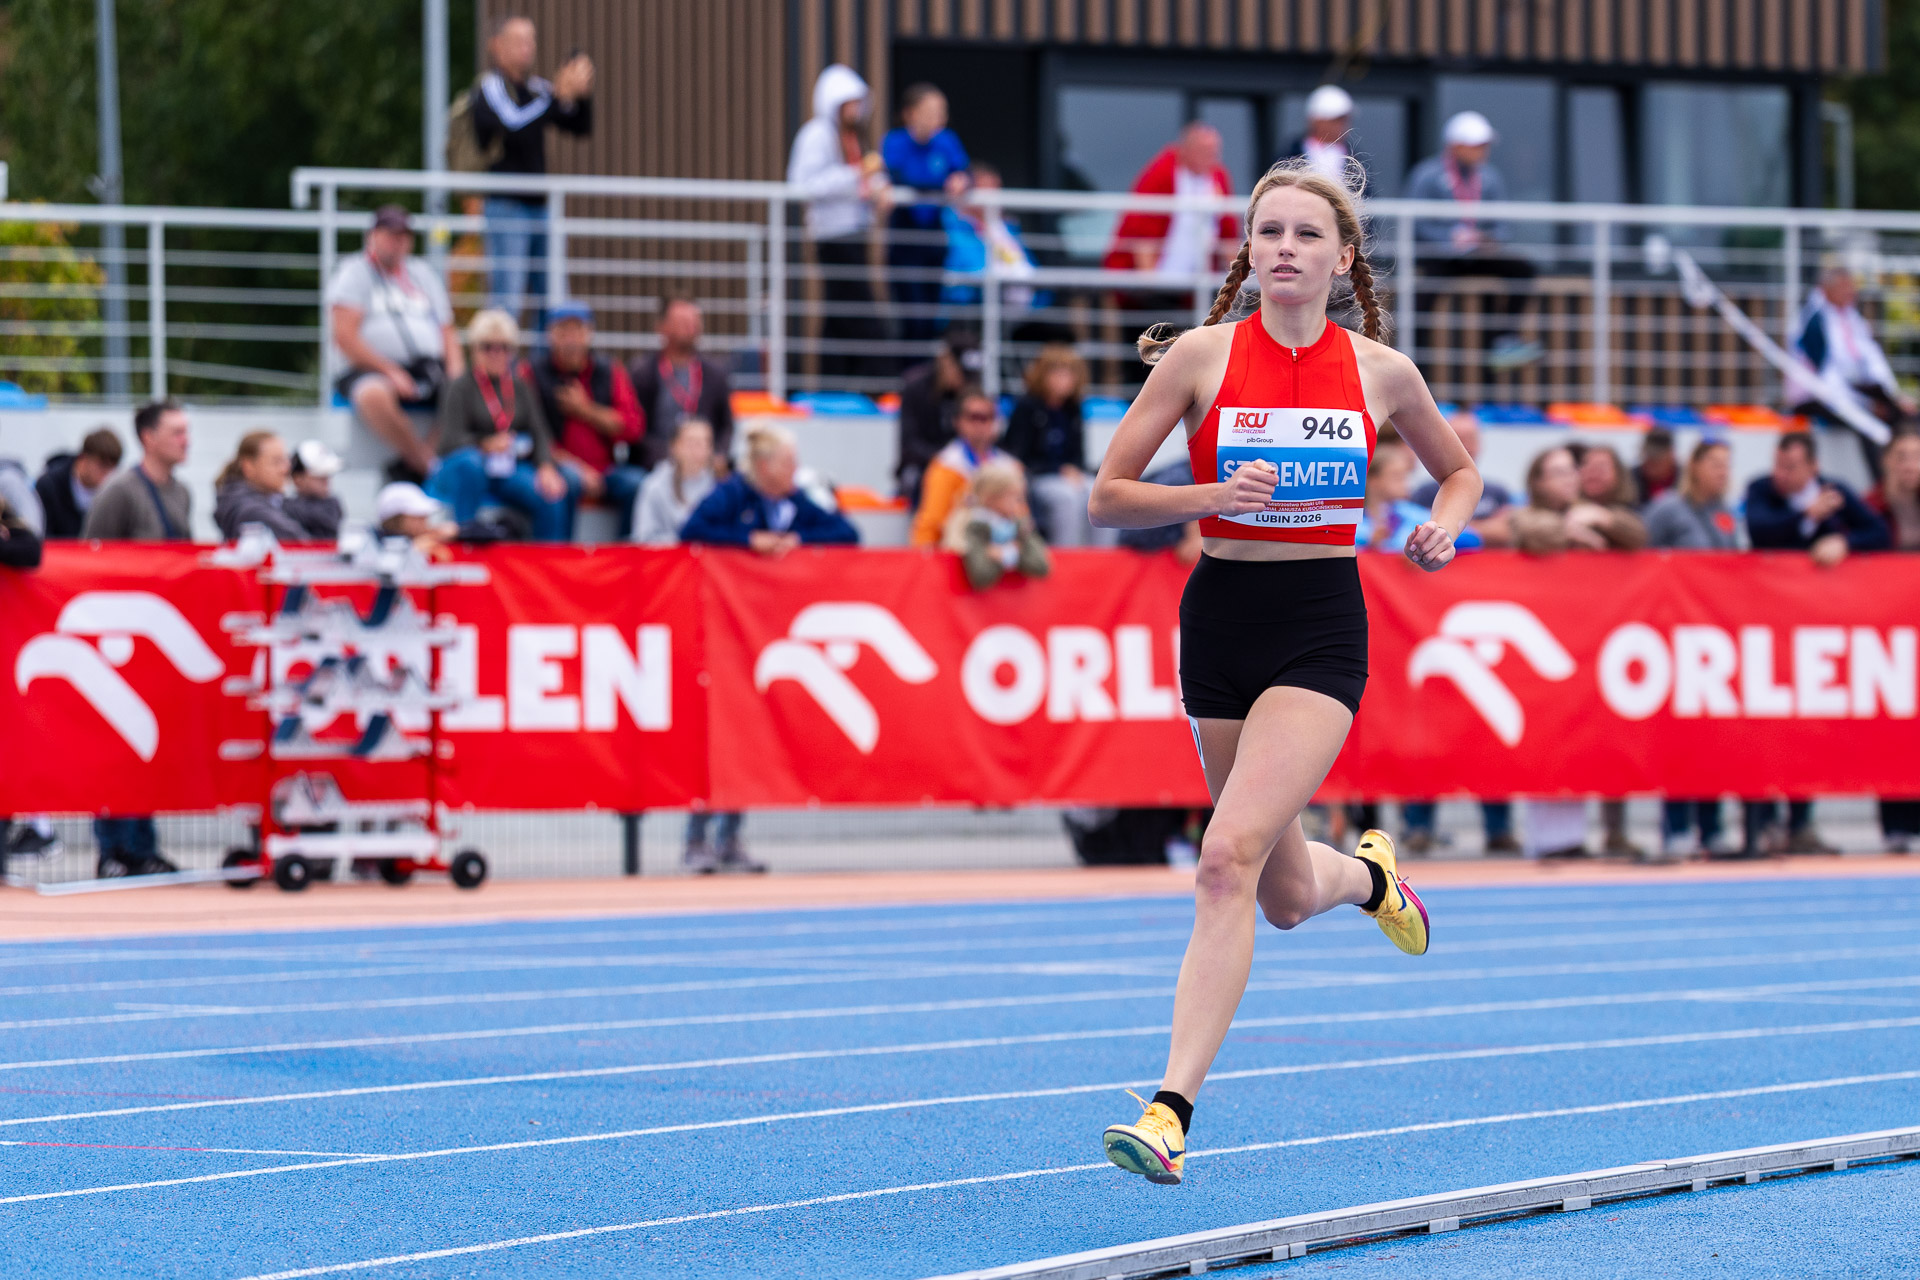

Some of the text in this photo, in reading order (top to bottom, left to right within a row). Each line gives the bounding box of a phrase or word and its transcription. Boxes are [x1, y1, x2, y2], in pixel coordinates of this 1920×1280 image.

[1233, 412, 1270, 428] RCU
[1302, 416, 1353, 440] 946
[1223, 459, 1359, 487] SEMETA
[1256, 513, 1322, 523] LUBIN 2026
[961, 624, 1180, 724] ORL
[1597, 622, 1918, 720] ORLEN
